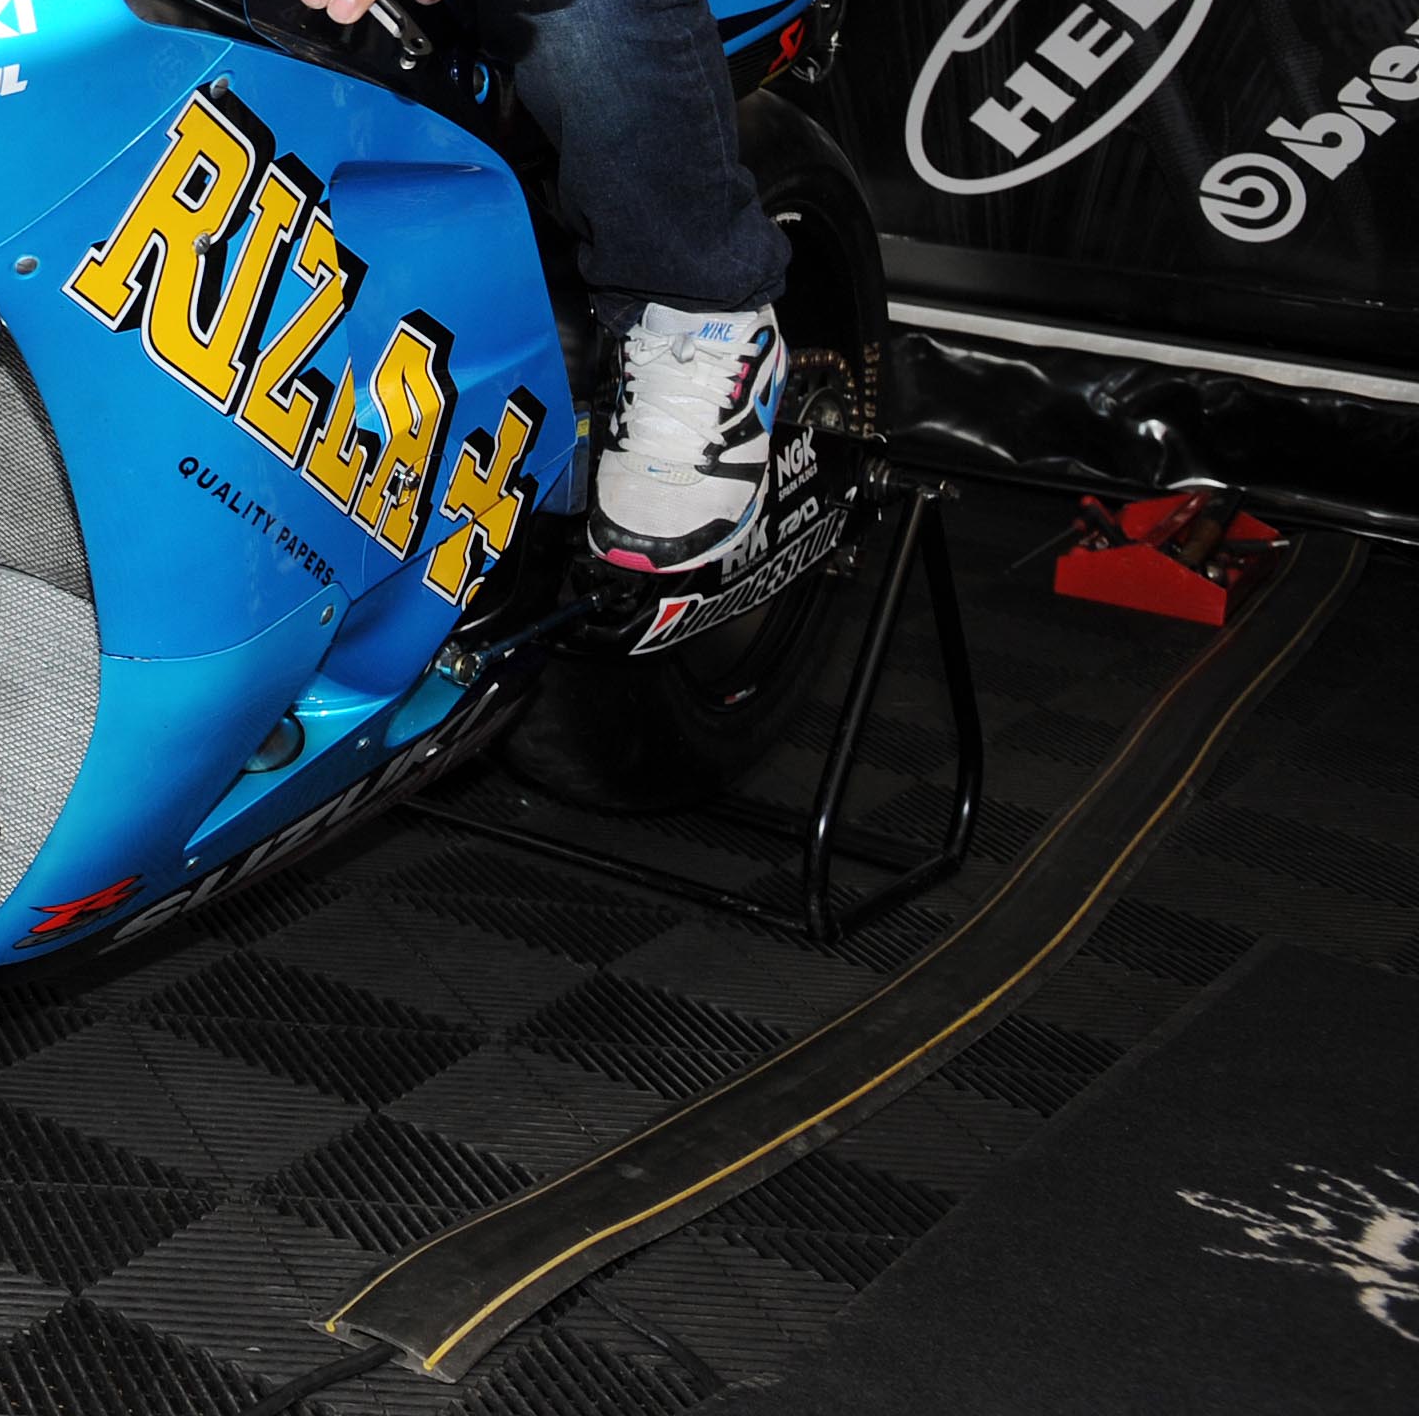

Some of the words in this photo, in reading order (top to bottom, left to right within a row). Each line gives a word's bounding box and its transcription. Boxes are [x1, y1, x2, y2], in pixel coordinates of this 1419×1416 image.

[1265, 18, 1419, 181] bre
[698, 321, 734, 342] NIKE
[776, 425, 818, 488] NGK
[178, 455, 278, 535] QUALITY
[274, 525, 337, 589] PAPERS
